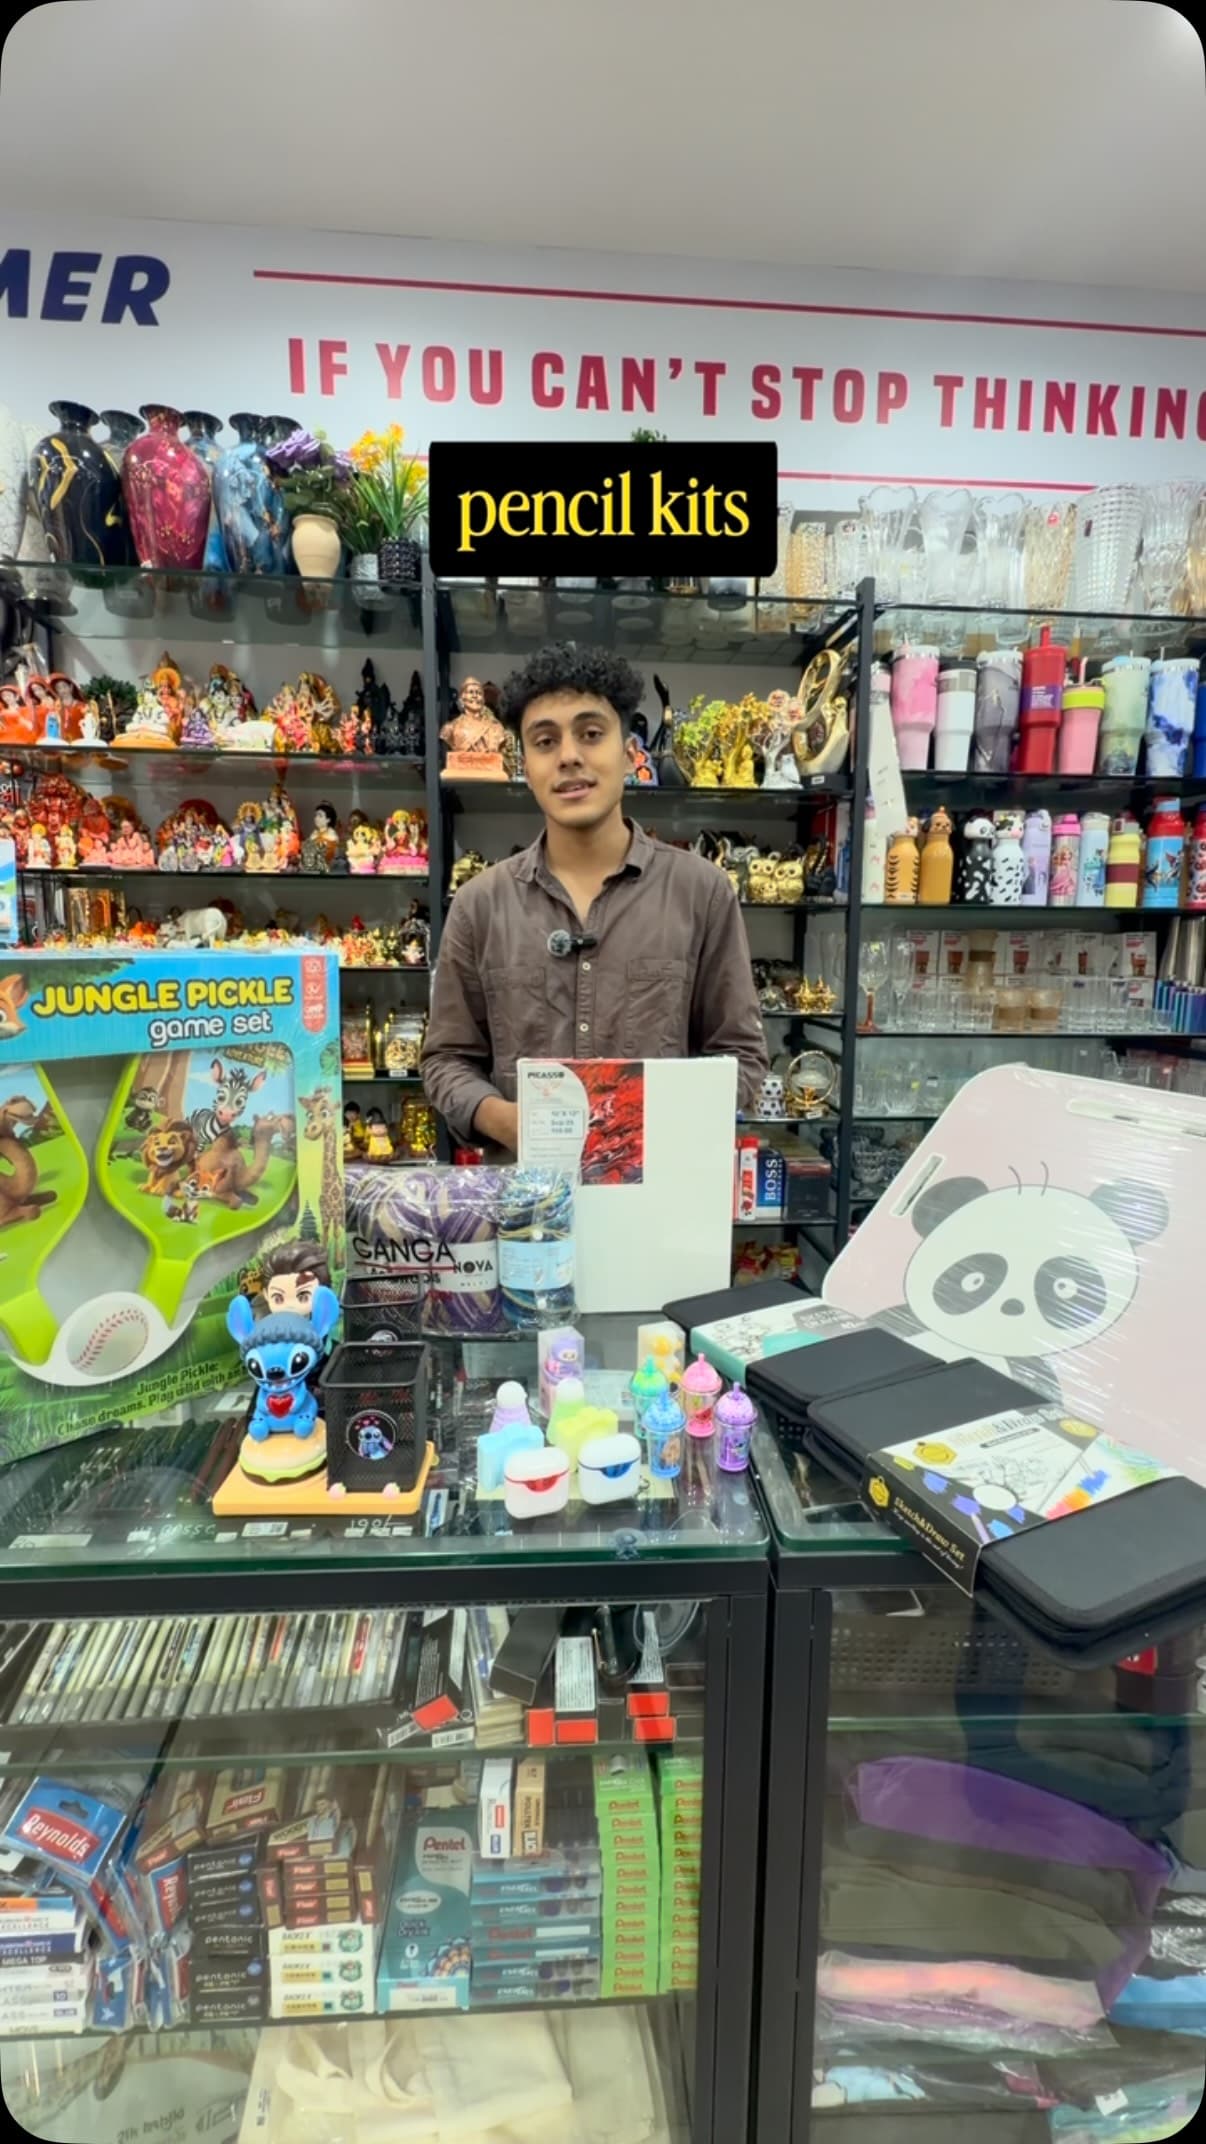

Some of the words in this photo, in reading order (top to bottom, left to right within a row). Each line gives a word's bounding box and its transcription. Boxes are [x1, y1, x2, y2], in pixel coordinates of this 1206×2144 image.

[288, 338, 348, 396] IF
[376, 344, 503, 406] YOU
[531, 352, 727, 417] CAN'T
[752, 364, 908, 426] STOP
[33, 983, 179, 1016] JUNGLE
[187, 978, 292, 1006] PICKLE
[150, 1016, 226, 1048] game
[233, 1011, 271, 1033] set
[527, 1071, 565, 1079] PICASSO
[765, 1158, 778, 1201] BOSS
[352, 1236, 457, 1264] GANGA
[453, 1259, 495, 1274] NOVA
[137, 1374, 179, 1397] Jungle
[21, 1813, 92, 1858] Reynolds
[422, 1836, 466, 1851] Pentel
[204, 1935, 254, 1945] pentonic
